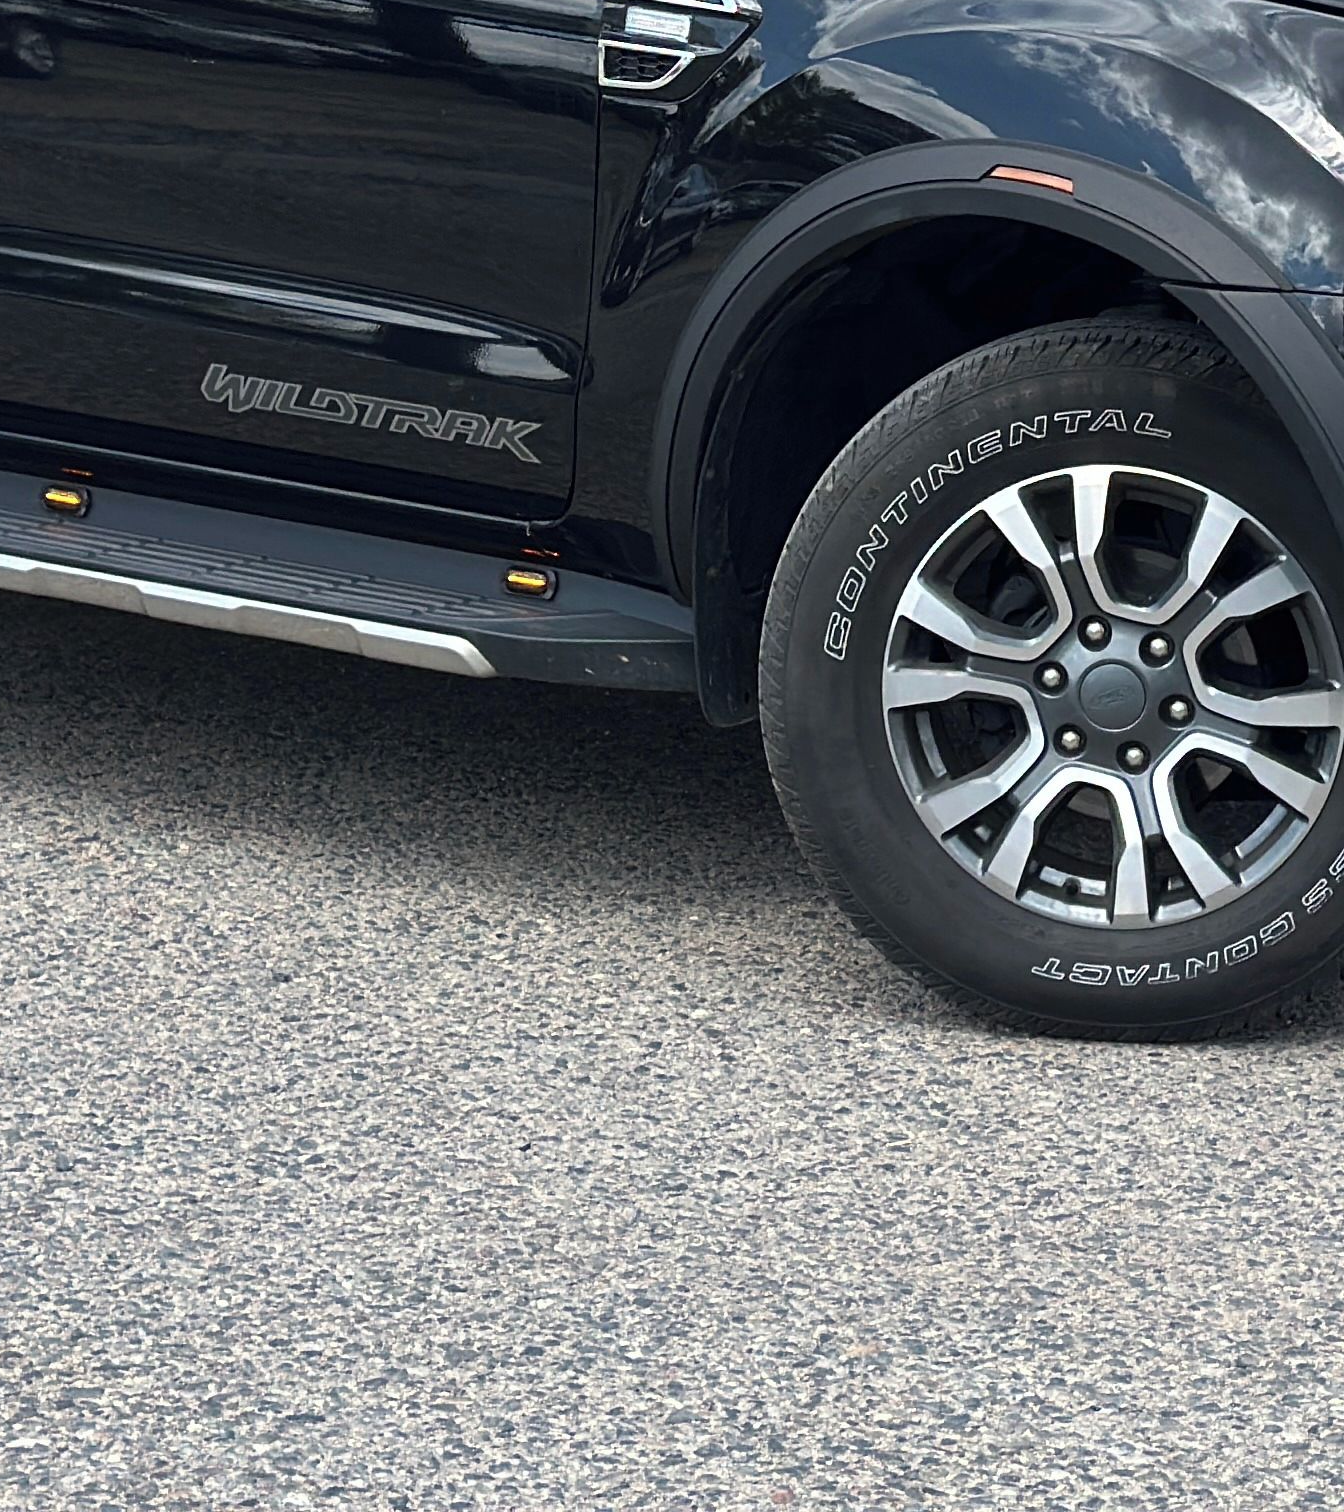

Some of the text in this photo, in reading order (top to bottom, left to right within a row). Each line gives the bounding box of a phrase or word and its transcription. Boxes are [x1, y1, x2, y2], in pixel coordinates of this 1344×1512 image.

[200, 362, 543, 464] WILDTRAK
[823, 408, 1174, 662] CONTINENTAL
[1032, 910, 1297, 987] CONTACT
